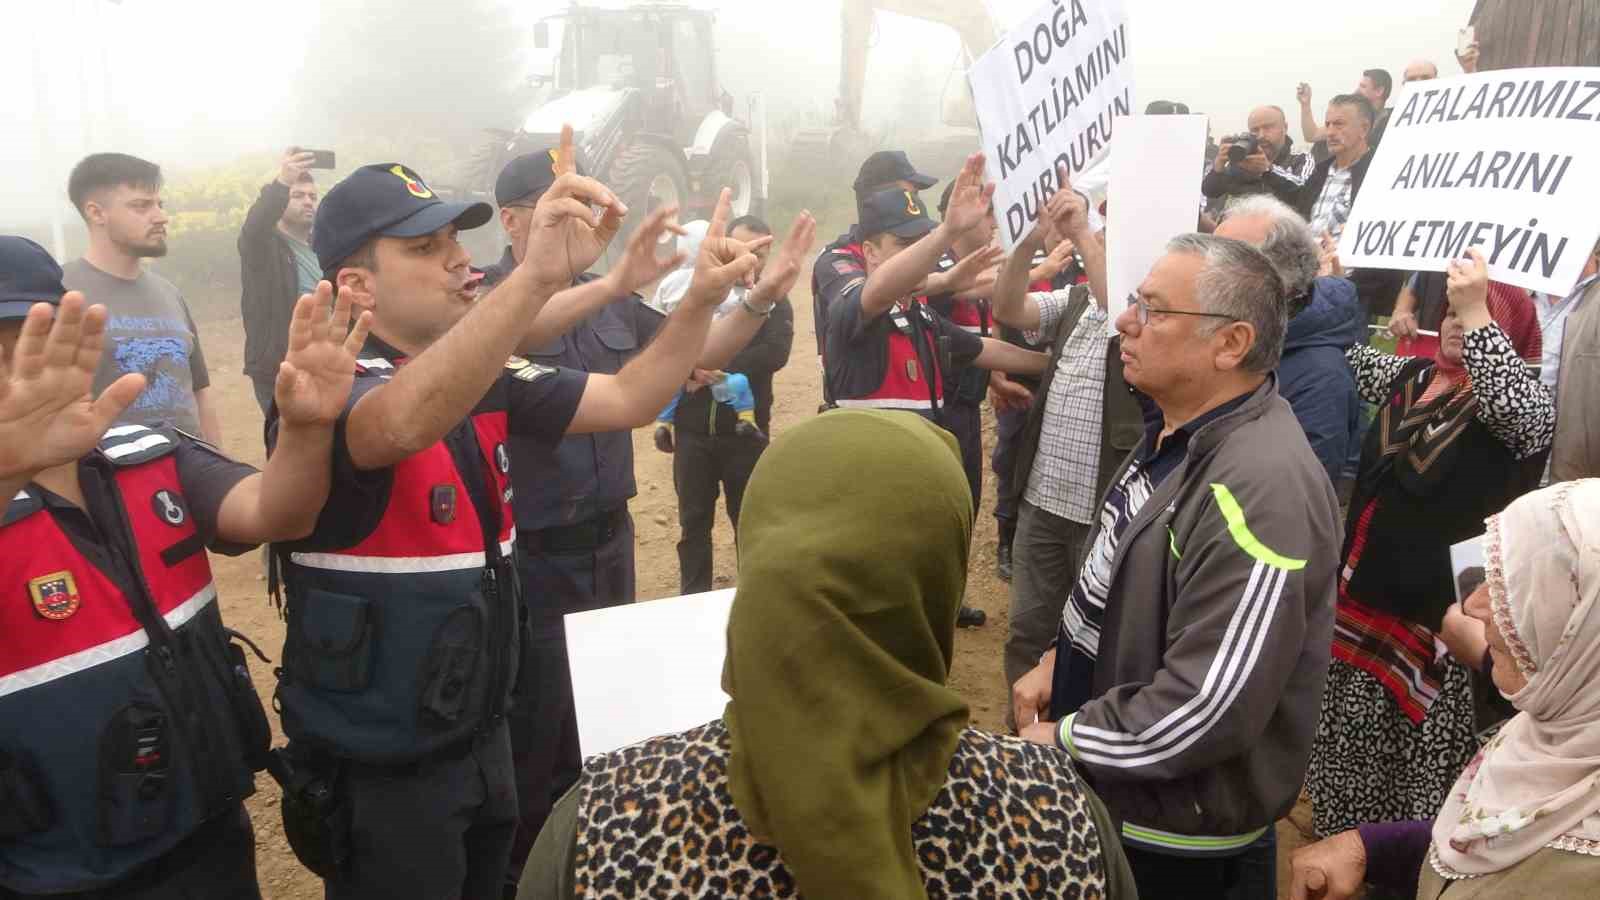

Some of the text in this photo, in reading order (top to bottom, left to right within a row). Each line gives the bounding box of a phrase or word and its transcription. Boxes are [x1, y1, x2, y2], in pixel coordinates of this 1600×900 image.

[1014, 0, 1088, 84] DOĞA
[997, 24, 1126, 180] KATLİAMINI
[1394, 79, 1600, 127] ATALARIMIZ
[1006, 87, 1130, 243] DURDURUN
[1391, 151, 1573, 195] ANILARINI
[1352, 217, 1569, 278] YOK ETMEYİN
